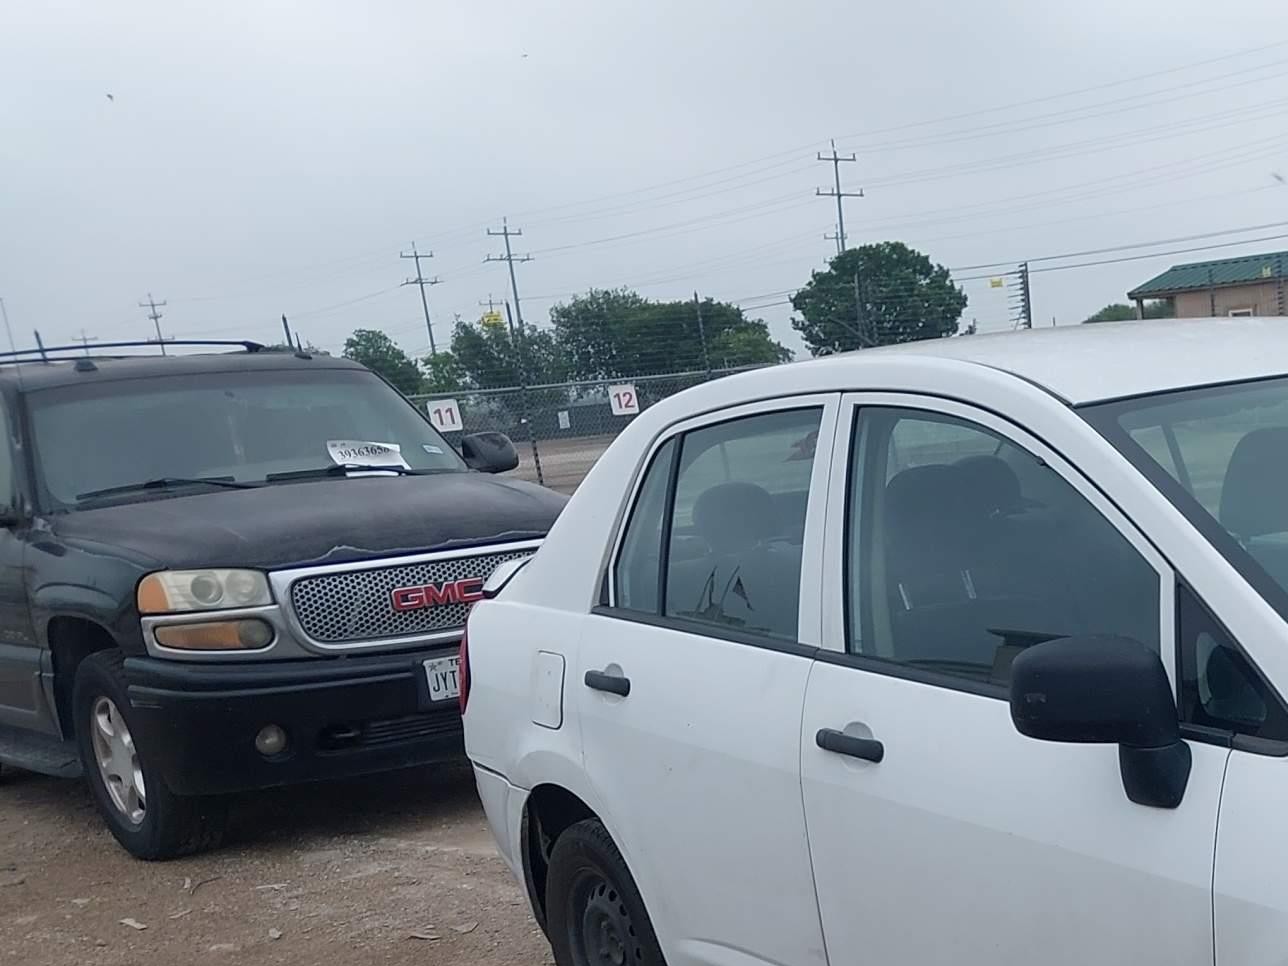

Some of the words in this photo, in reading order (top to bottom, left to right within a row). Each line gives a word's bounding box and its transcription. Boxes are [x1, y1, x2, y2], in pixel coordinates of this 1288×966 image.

[613, 391, 635, 409] 12
[433, 407, 456, 426] 11
[391, 576, 483, 611] GMC
